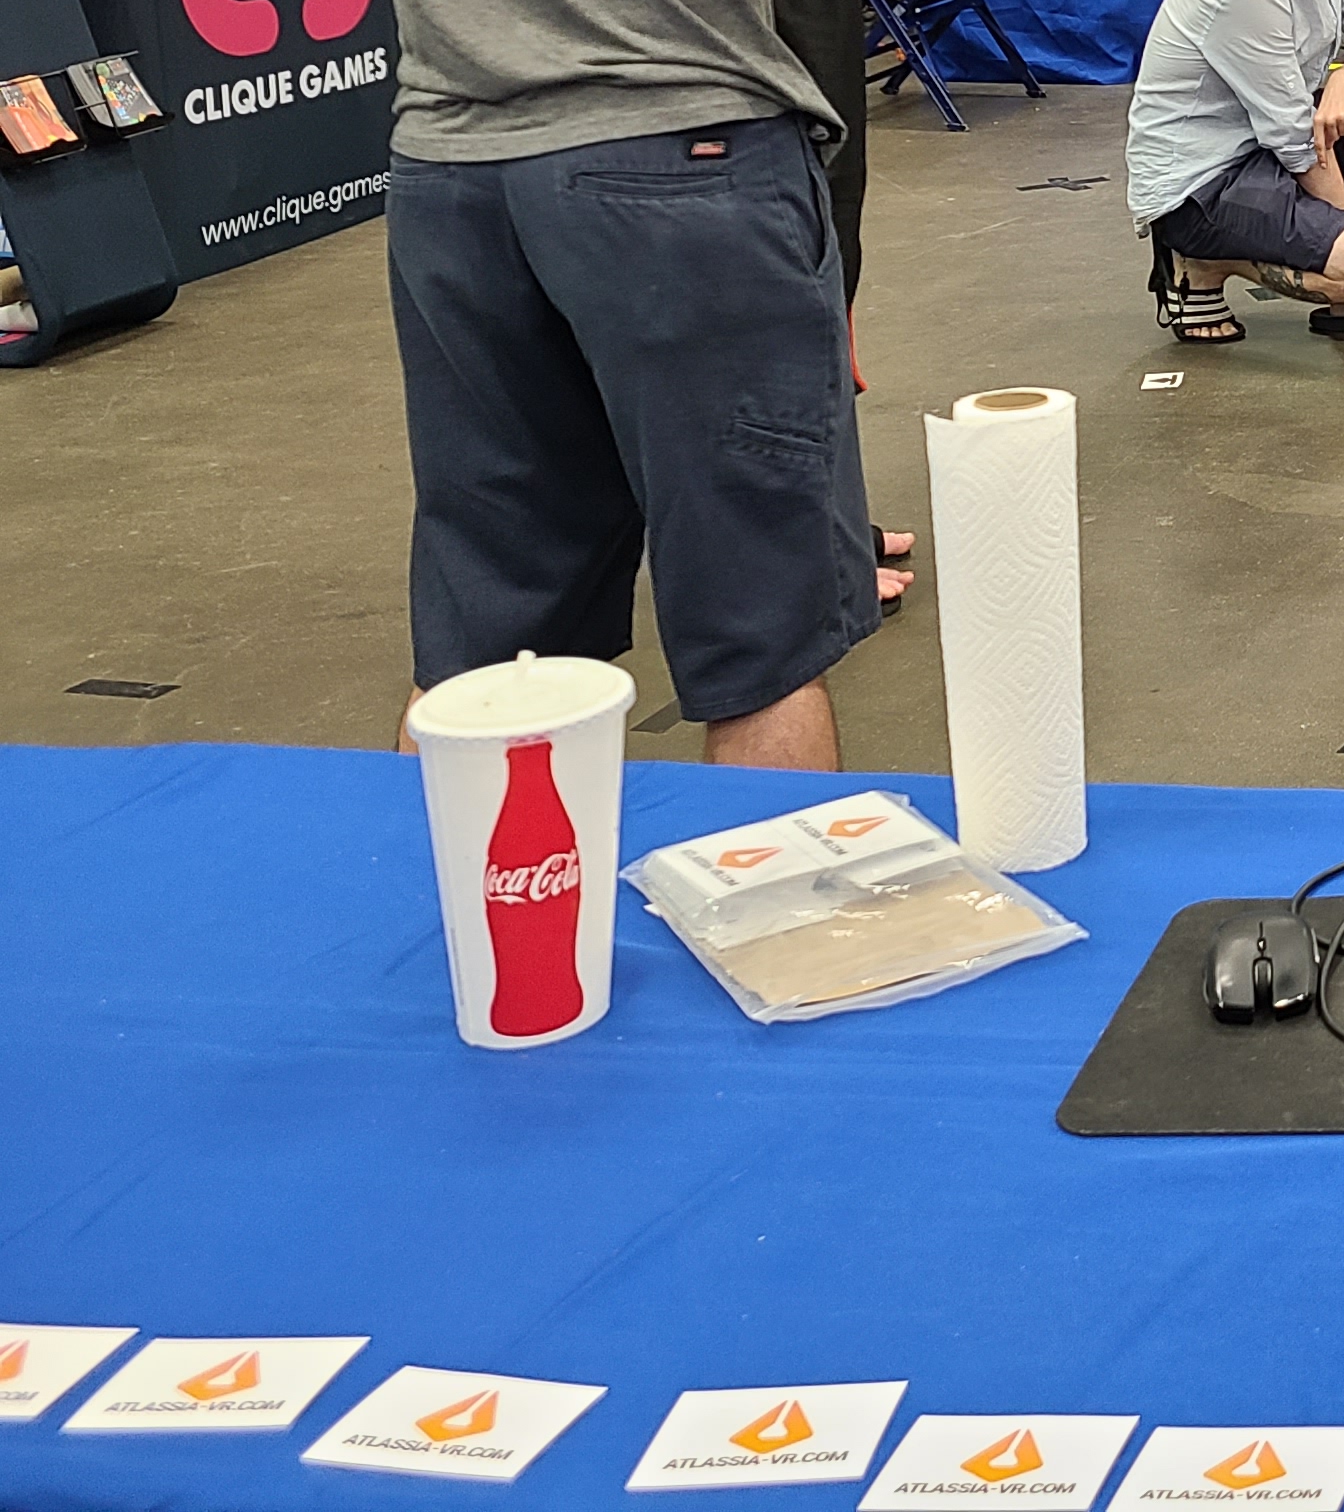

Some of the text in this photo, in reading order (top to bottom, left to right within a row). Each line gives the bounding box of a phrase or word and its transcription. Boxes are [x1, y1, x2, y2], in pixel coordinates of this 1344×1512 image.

[184, 47, 388, 125] CLIQUE GAMES
[201, 171, 392, 246] www.clique.games
[485, 849, 579, 904] Coca-Cola
[104, 1399, 286, 1412] ATLASSIA-VR.COM
[342, 1433, 518, 1463] ATLASSIA-VR.COM
[664, 1450, 850, 1473] ATLASSIA-VR.COM
[894, 1481, 1077, 1496] ATLASSIA-VR.COM
[1139, 1488, 1323, 1503] ATLASSIA-VR.COM
